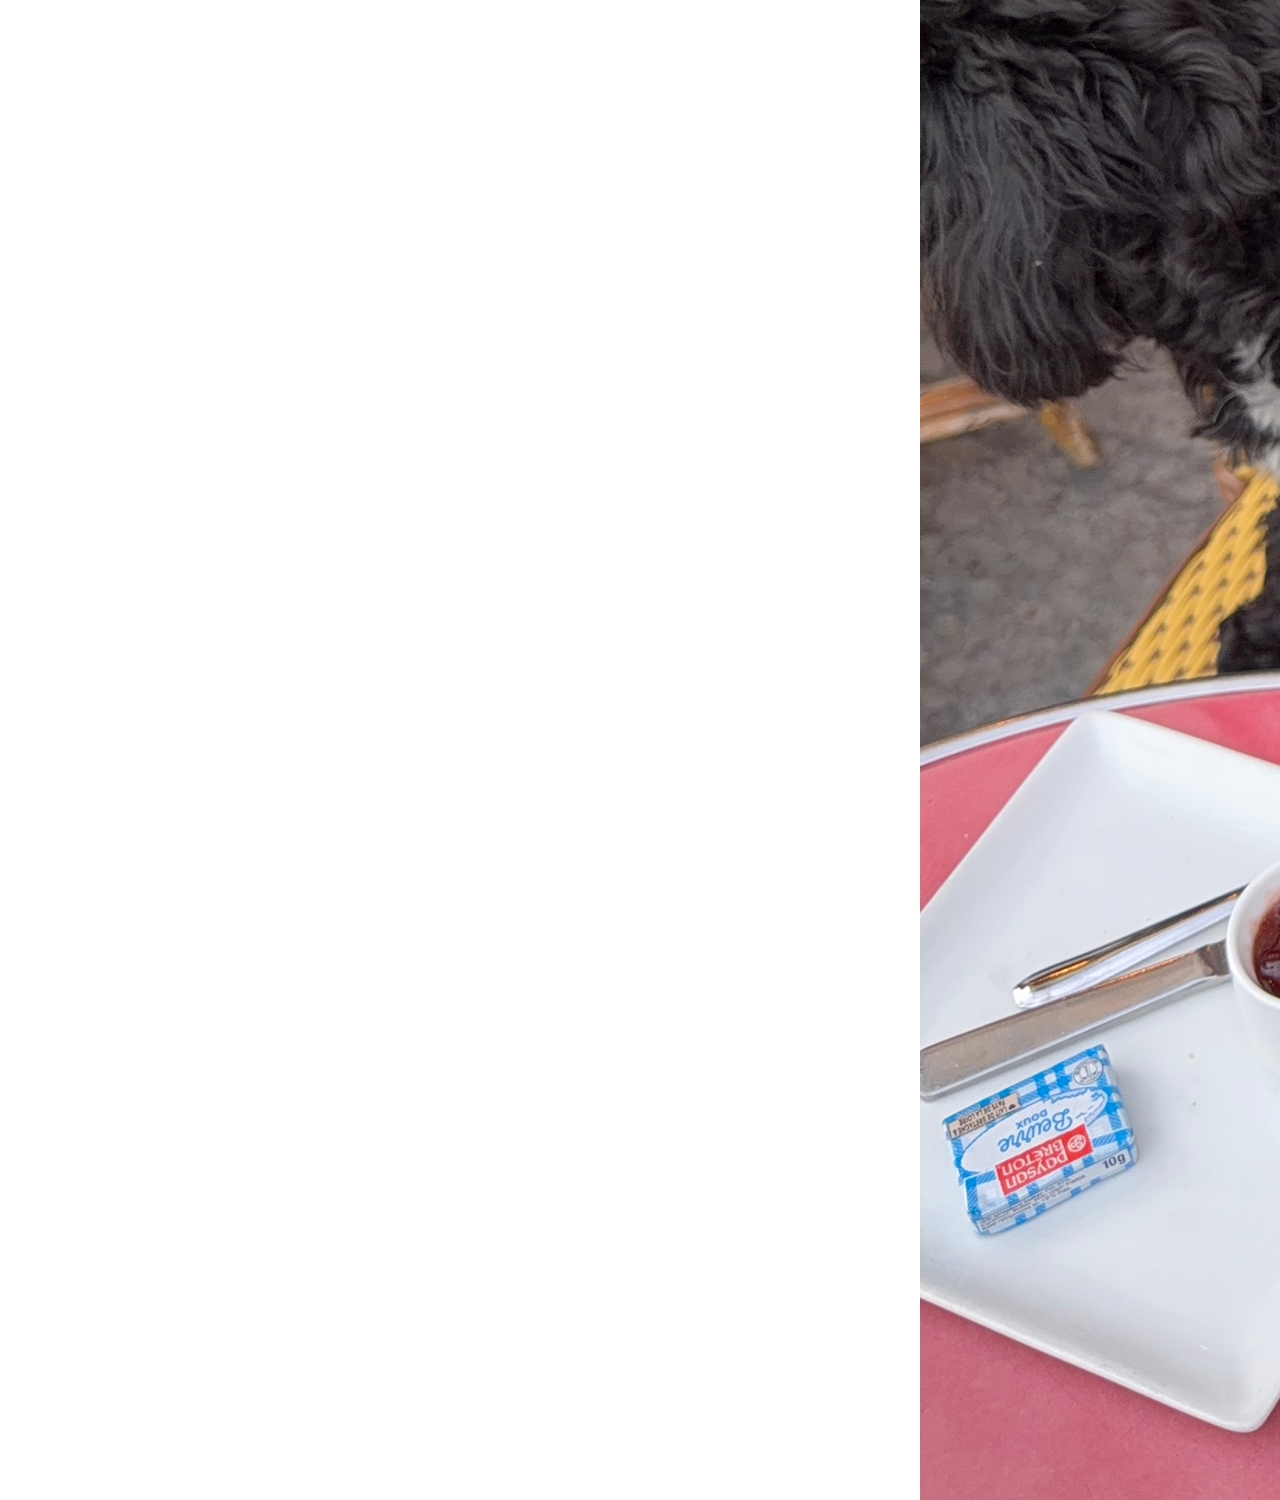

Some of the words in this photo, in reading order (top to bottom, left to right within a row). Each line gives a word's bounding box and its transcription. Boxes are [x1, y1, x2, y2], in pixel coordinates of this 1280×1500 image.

[991, 1100, 1006, 1110] PAYS
[996, 1106, 1007, 1116] LAIT
[959, 1112, 975, 1126] LOIRE
[1016, 1109, 1048, 1130] DOUX
[998, 1108, 1073, 1152] Beurre
[1102, 1154, 1126, 1168] 10g
[1004, 1150, 1068, 1190] paysan
